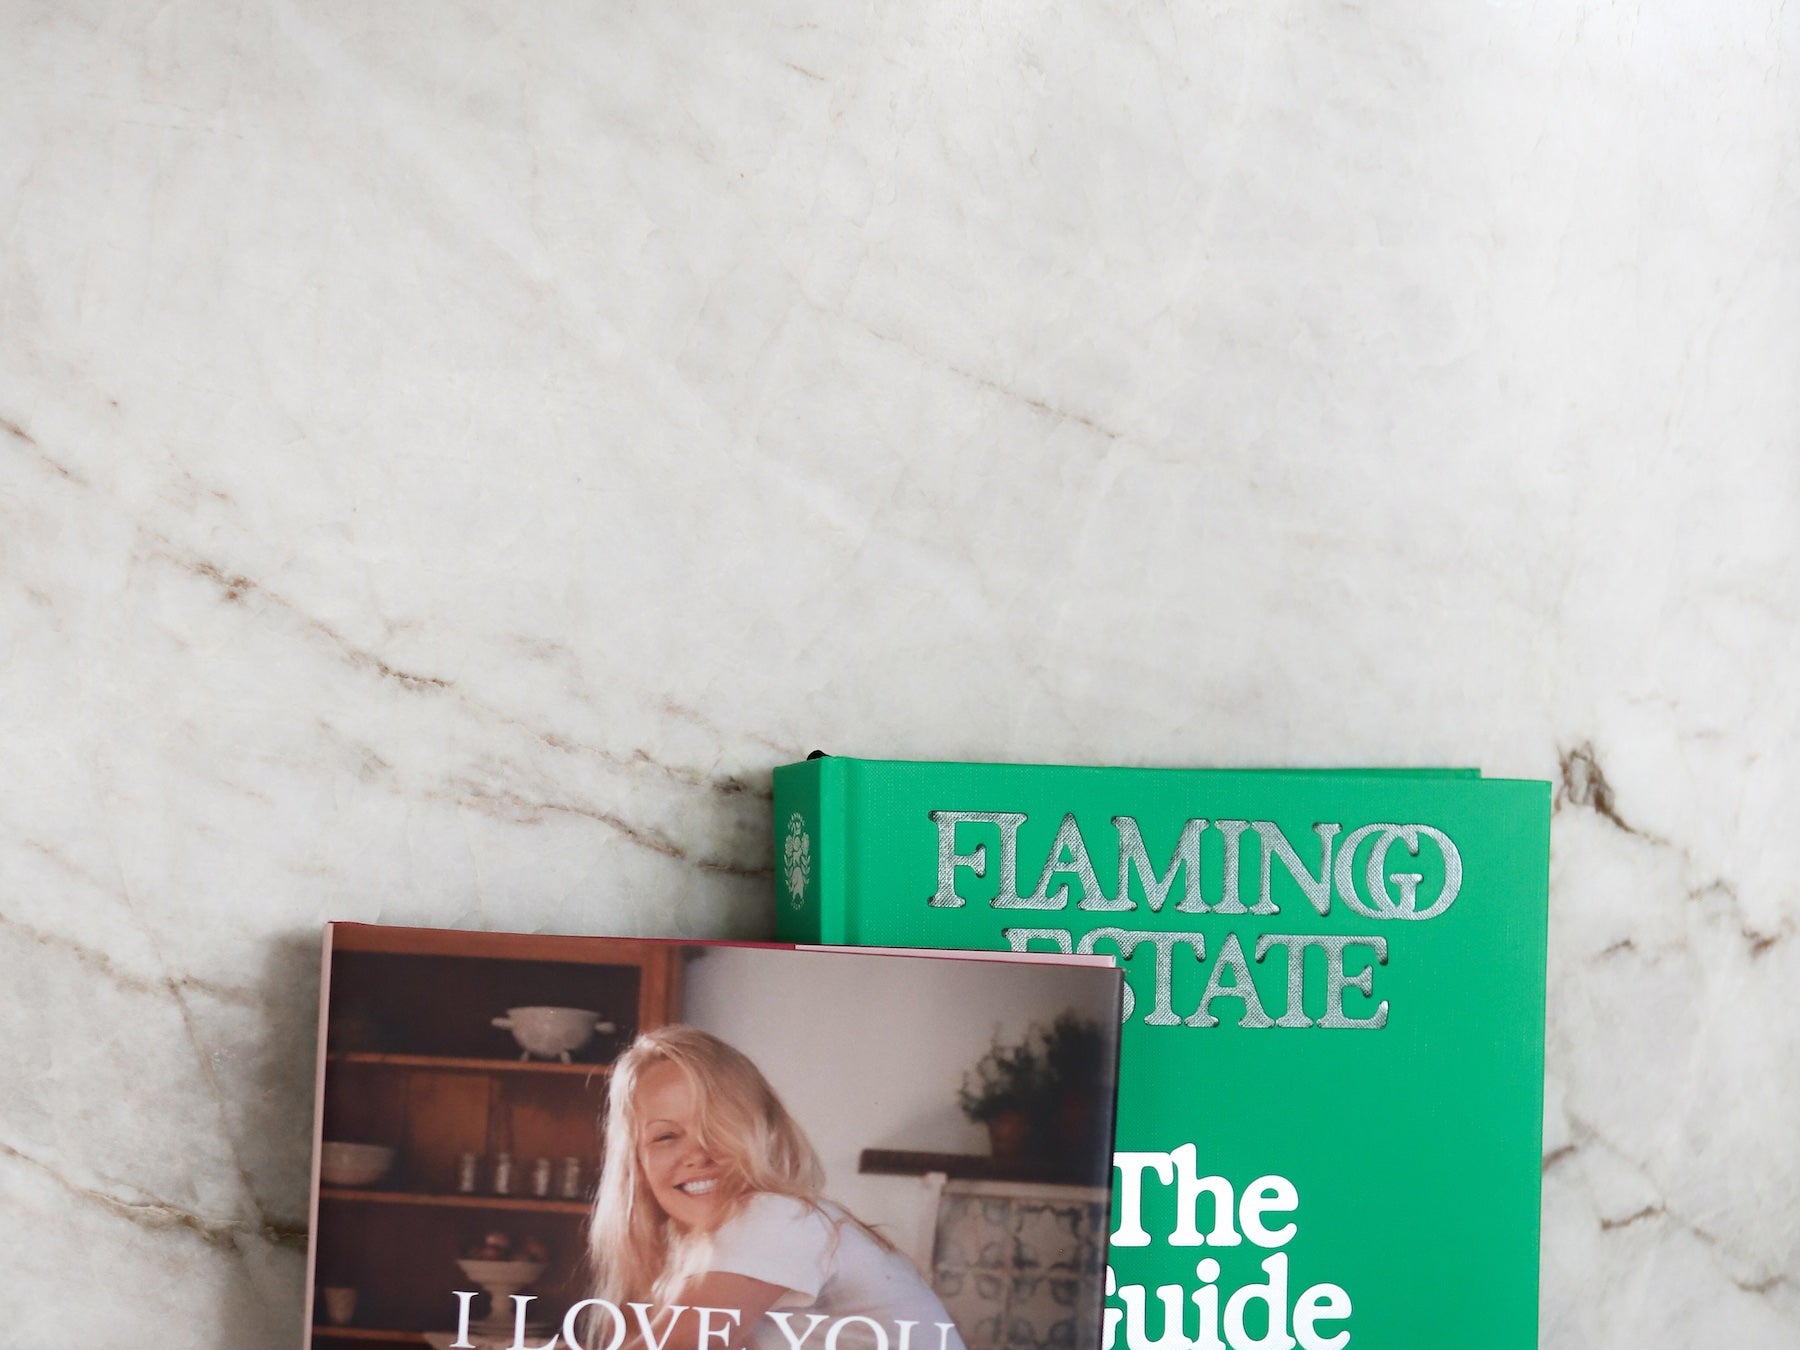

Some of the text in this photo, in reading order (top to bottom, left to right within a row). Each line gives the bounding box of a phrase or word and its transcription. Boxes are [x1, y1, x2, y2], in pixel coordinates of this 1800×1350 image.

[926, 810, 1465, 921] FLAMINGO
[1001, 926, 1390, 1030] TATE
[1109, 1142, 1299, 1247] The
[450, 1290, 479, 1349] I
